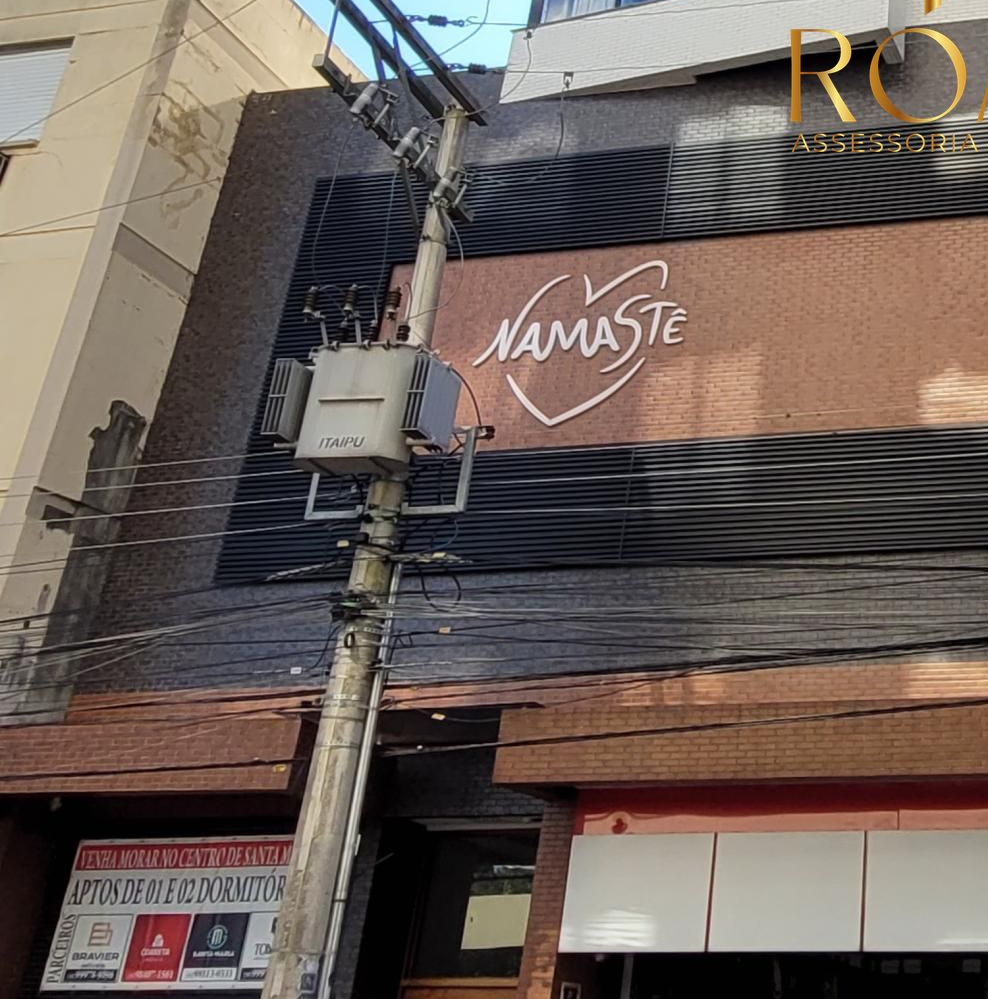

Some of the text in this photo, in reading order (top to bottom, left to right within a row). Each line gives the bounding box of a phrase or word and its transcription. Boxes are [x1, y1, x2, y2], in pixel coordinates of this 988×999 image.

[472, 275, 688, 373] NAMASTÊ
[318, 436, 366, 449] ITAIPU
[81, 850, 117, 869] VENHA
[117, 849, 160, 868] MORAR
[159, 847, 178, 867] NO
[179, 847, 226, 867] CENTRO
[225, 846, 243, 866] DE
[242, 845, 280, 865] SANTA
[67, 867, 287, 906] APTOS DE 01 E 02 DORMITÓR
[46, 913, 76, 983] PARCEIROS
[71, 952, 120, 961] BRAVIER
